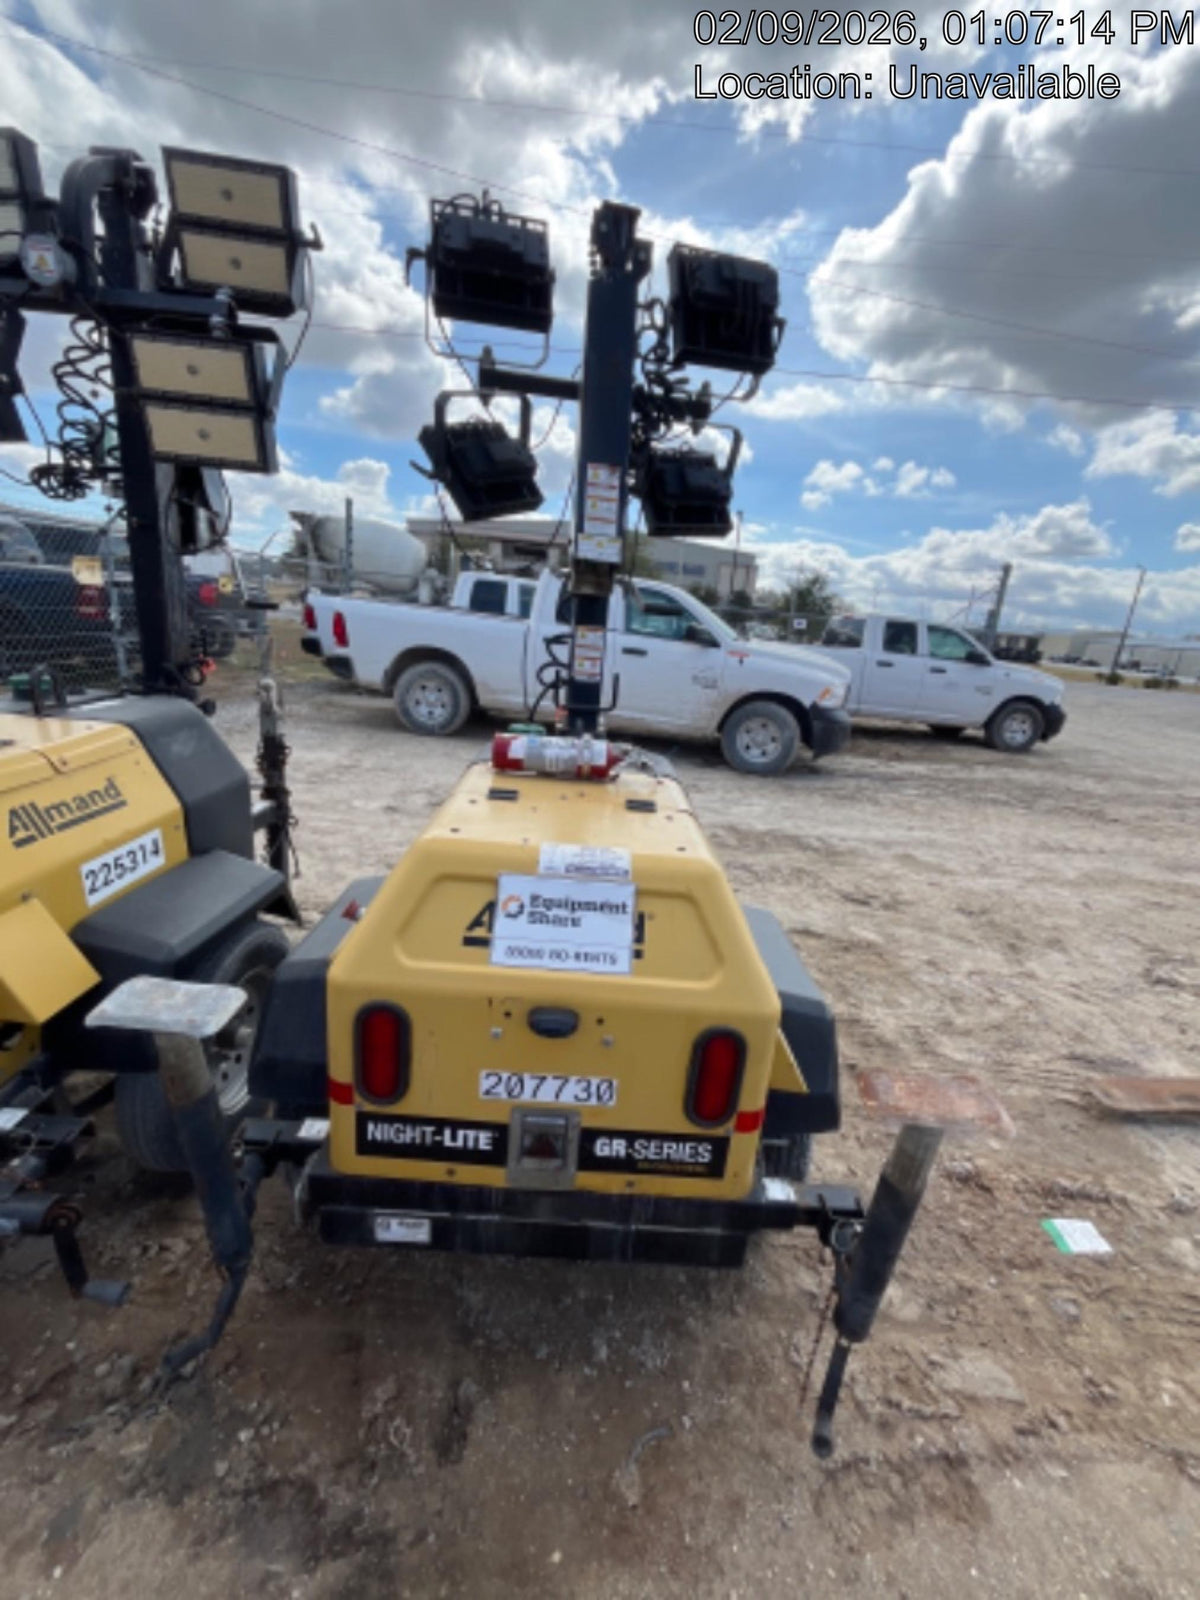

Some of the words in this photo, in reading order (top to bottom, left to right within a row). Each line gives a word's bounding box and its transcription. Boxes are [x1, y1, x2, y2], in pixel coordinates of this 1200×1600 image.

[8, 775, 123, 839] Allmand
[84, 836, 161, 896] 225314
[526, 910, 582, 928] Share
[529, 893, 629, 916] Equipment
[482, 1071, 616, 1105] 207730
[366, 1119, 494, 1152] NIGHT-LITE
[593, 1135, 712, 1163] GR-SERIES
